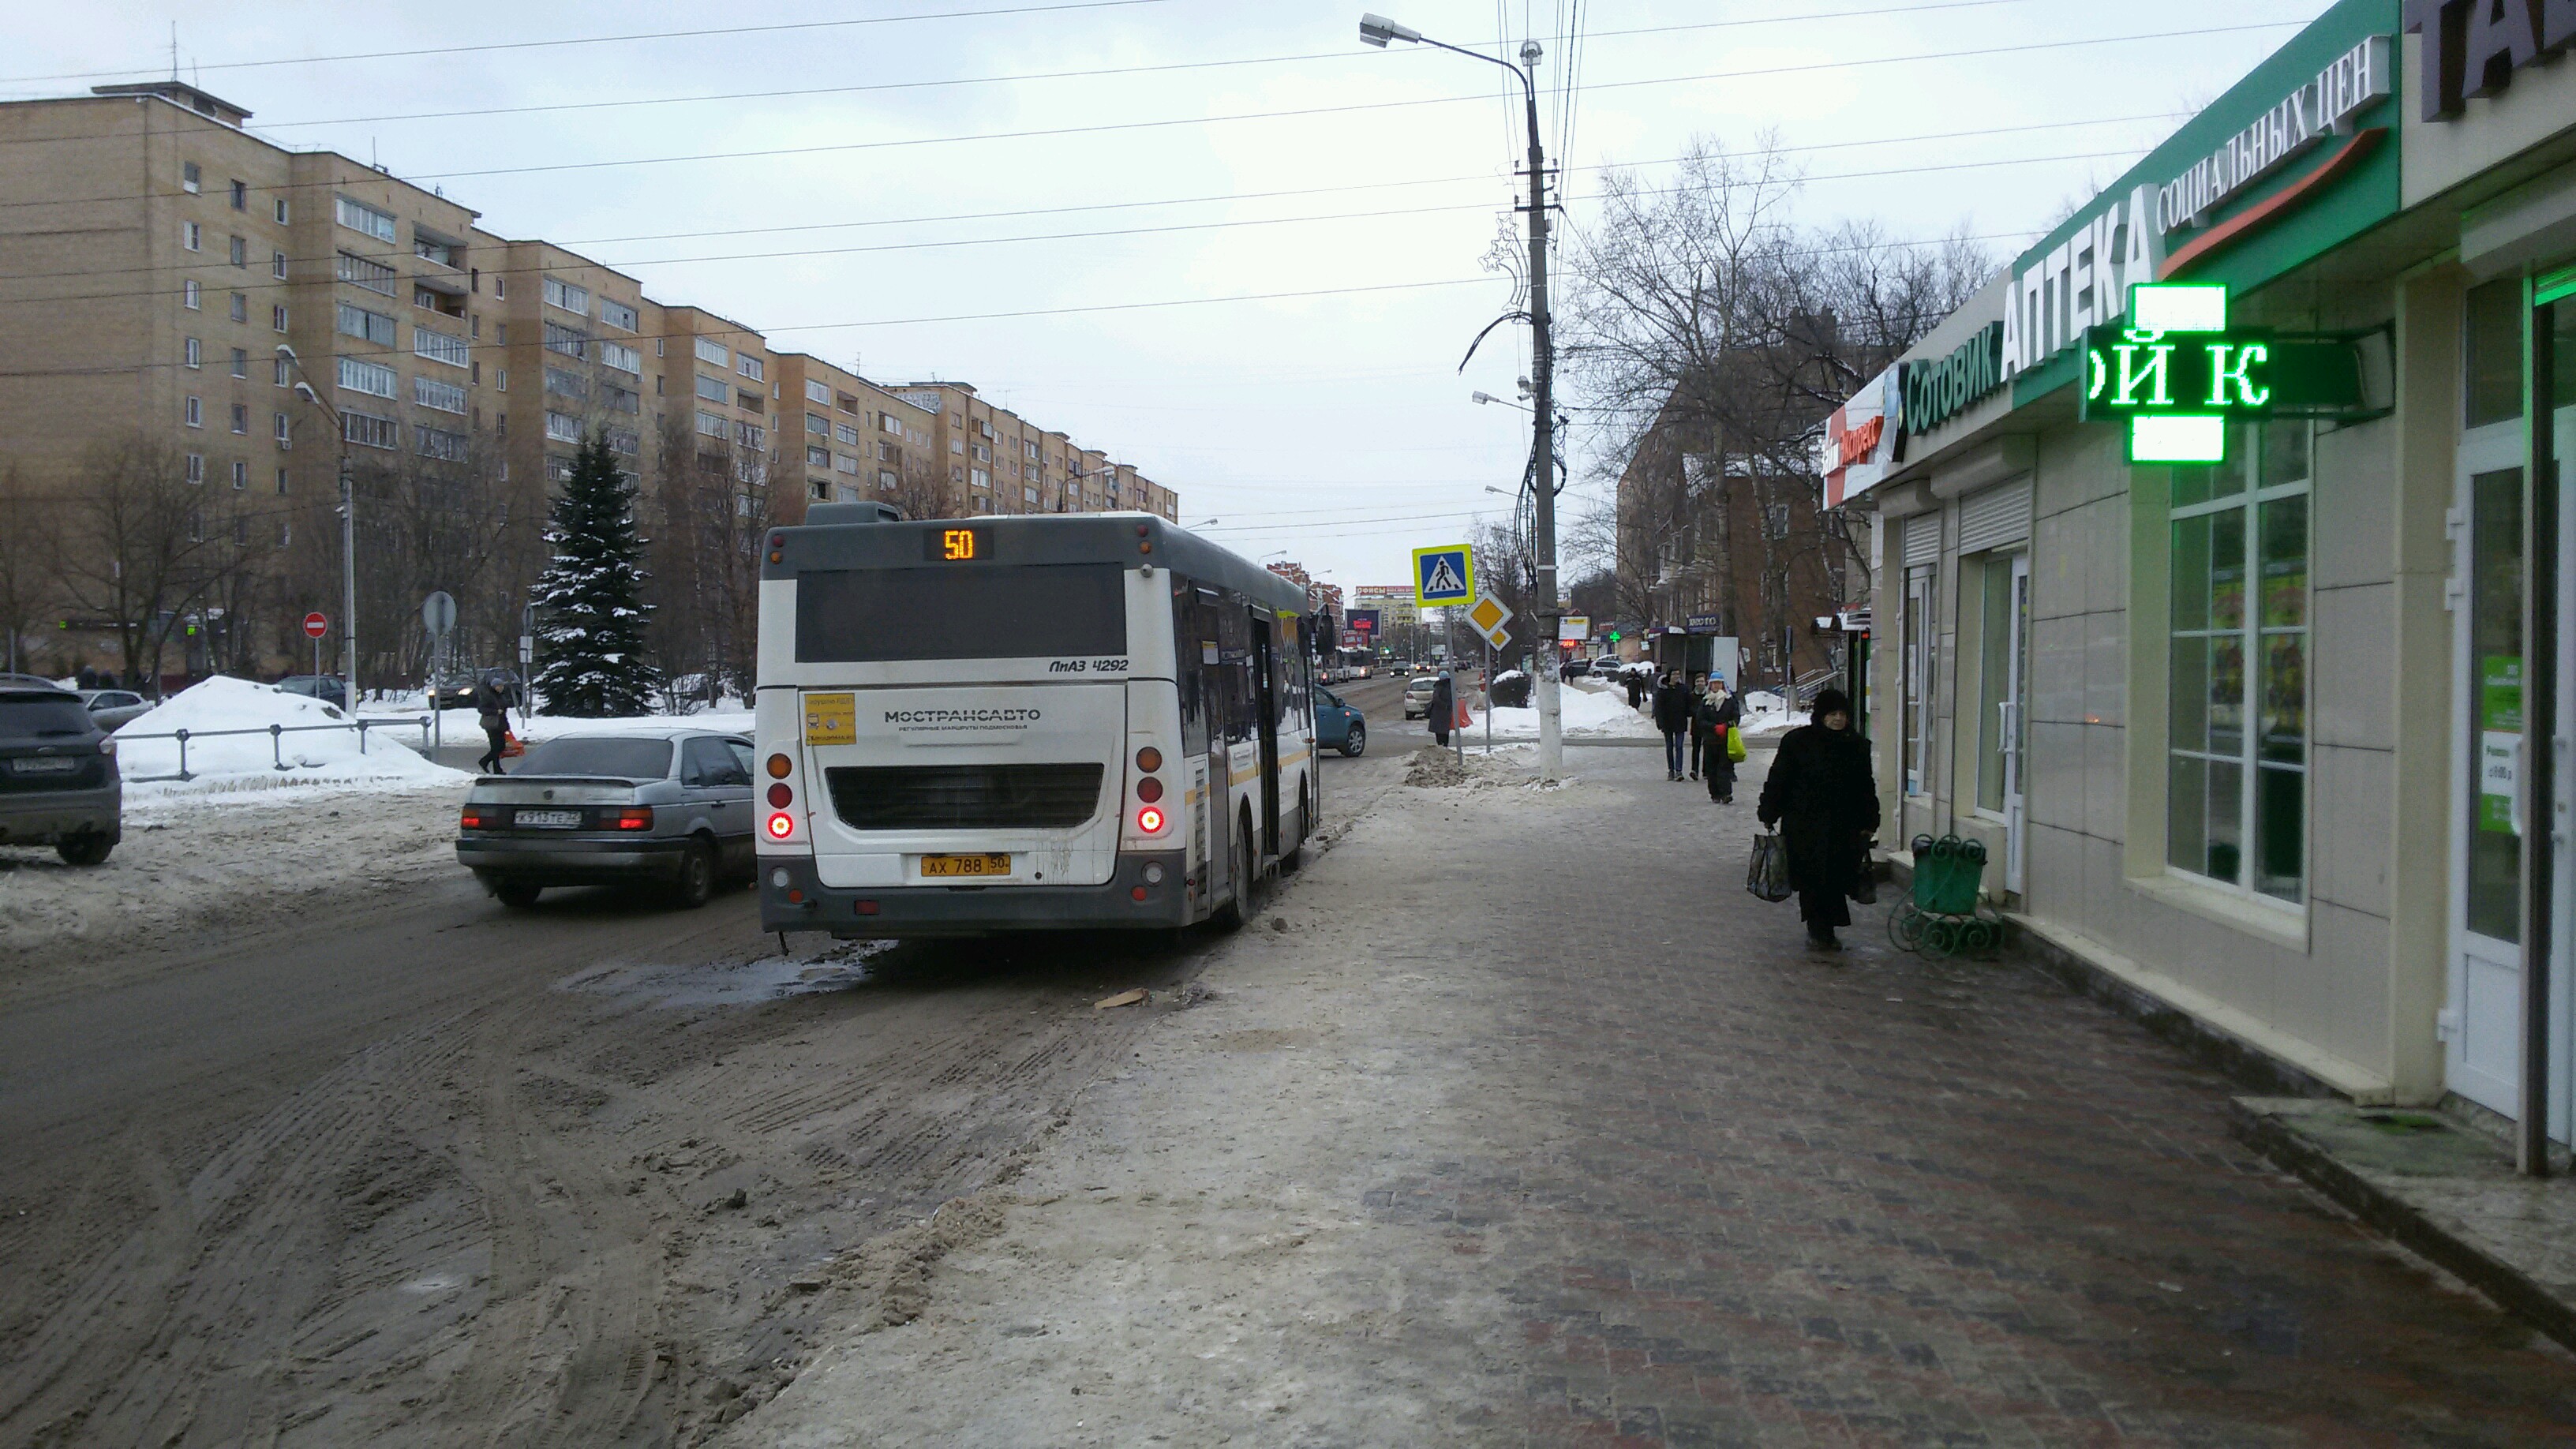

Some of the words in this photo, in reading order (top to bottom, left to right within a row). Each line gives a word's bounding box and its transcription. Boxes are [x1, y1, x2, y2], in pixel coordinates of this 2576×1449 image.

[2403, 0, 2576, 123] ТА
[2156, 84, 2308, 236] СОЦИАЛЬНЫХ
[2316, 35, 2373, 135] ЦЕН
[2000, 184, 2154, 384] АПТЕКА
[945, 530, 973, 560] 50
[1049, 661, 1087, 672] ЛиАЗ
[1092, 659, 1129, 672] 4292
[885, 709, 1042, 723] МОСТРАНСАВТО
[929, 862, 947, 874] АХ
[953, 859, 982, 873] 788
[990, 857, 1005, 868] 50
